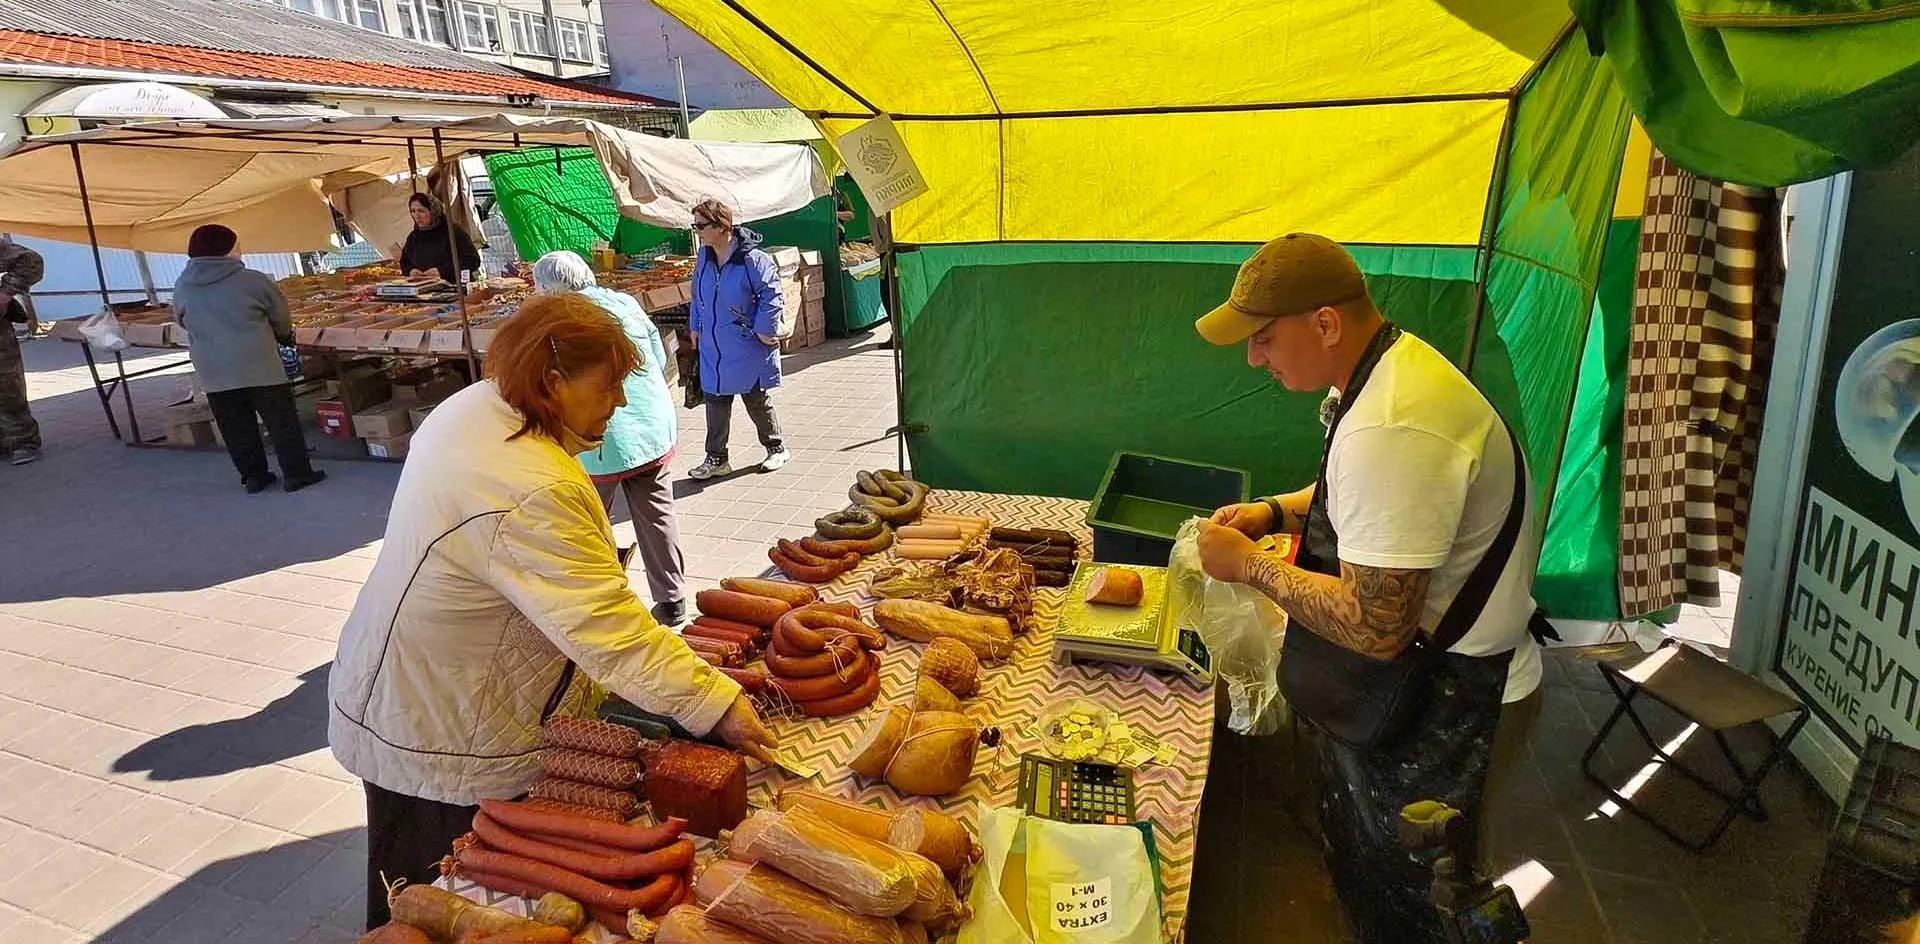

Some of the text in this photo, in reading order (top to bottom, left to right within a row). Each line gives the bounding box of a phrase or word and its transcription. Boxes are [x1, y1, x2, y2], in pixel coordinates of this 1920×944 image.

[1803, 501, 1920, 650] МИН
[1793, 584, 1920, 732] ПРЕДУП
[1786, 639, 1861, 727] КУРЕНИЕ
[1071, 884, 1095, 896] M-1
[1056, 901, 1075, 912] 40
[1092, 896, 1107, 909] 30
[1058, 911, 1107, 929] EXTRA
